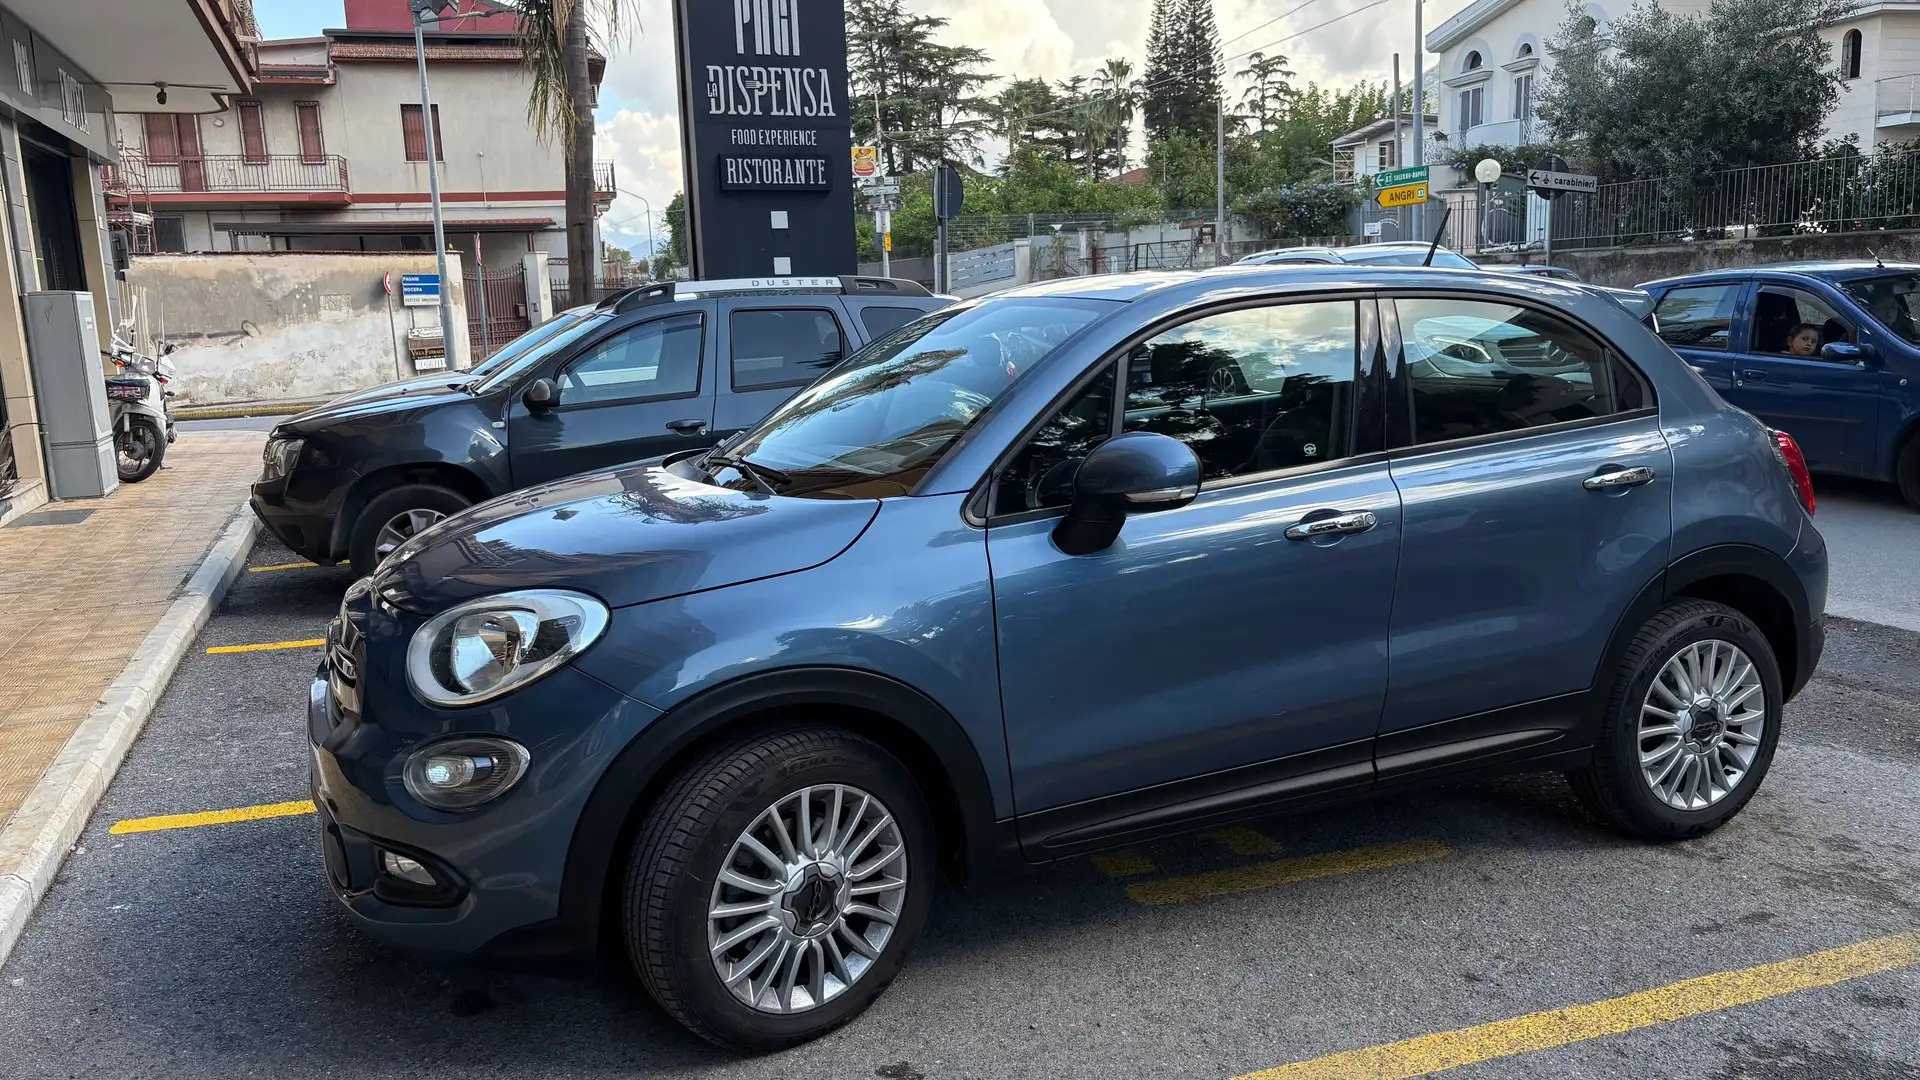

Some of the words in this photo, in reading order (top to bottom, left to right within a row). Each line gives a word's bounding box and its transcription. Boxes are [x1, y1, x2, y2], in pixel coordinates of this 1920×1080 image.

[705, 65, 837, 117] DISPENSA
[706, 82, 719, 98] LA
[731, 128, 757, 146] FOOD
[758, 129, 818, 147] EXPERIENCE
[725, 158, 827, 185] RISTORANTE
[1553, 177, 1596, 189] carabinieri
[1388, 189, 1415, 203] ANGRI
[751, 279, 835, 287] DUSTER
